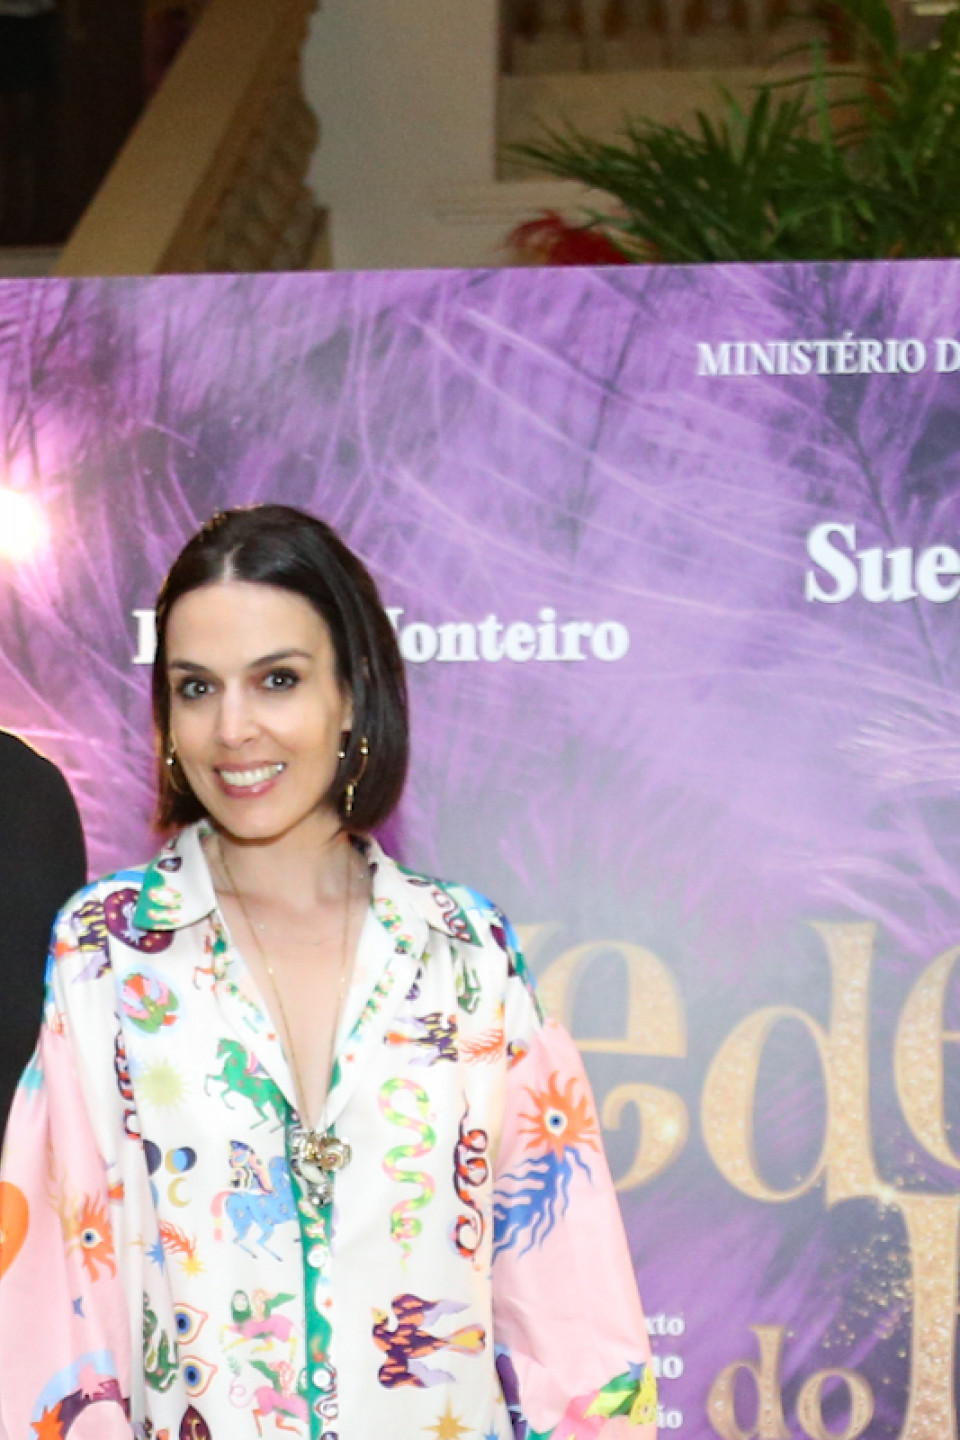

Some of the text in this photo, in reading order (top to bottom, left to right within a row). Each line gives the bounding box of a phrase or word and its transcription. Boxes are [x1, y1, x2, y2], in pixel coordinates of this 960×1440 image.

[697, 331, 927, 376] MINISTÉRIO
[806, 522, 960, 604] Sue
[385, 607, 630, 663] onteiro
